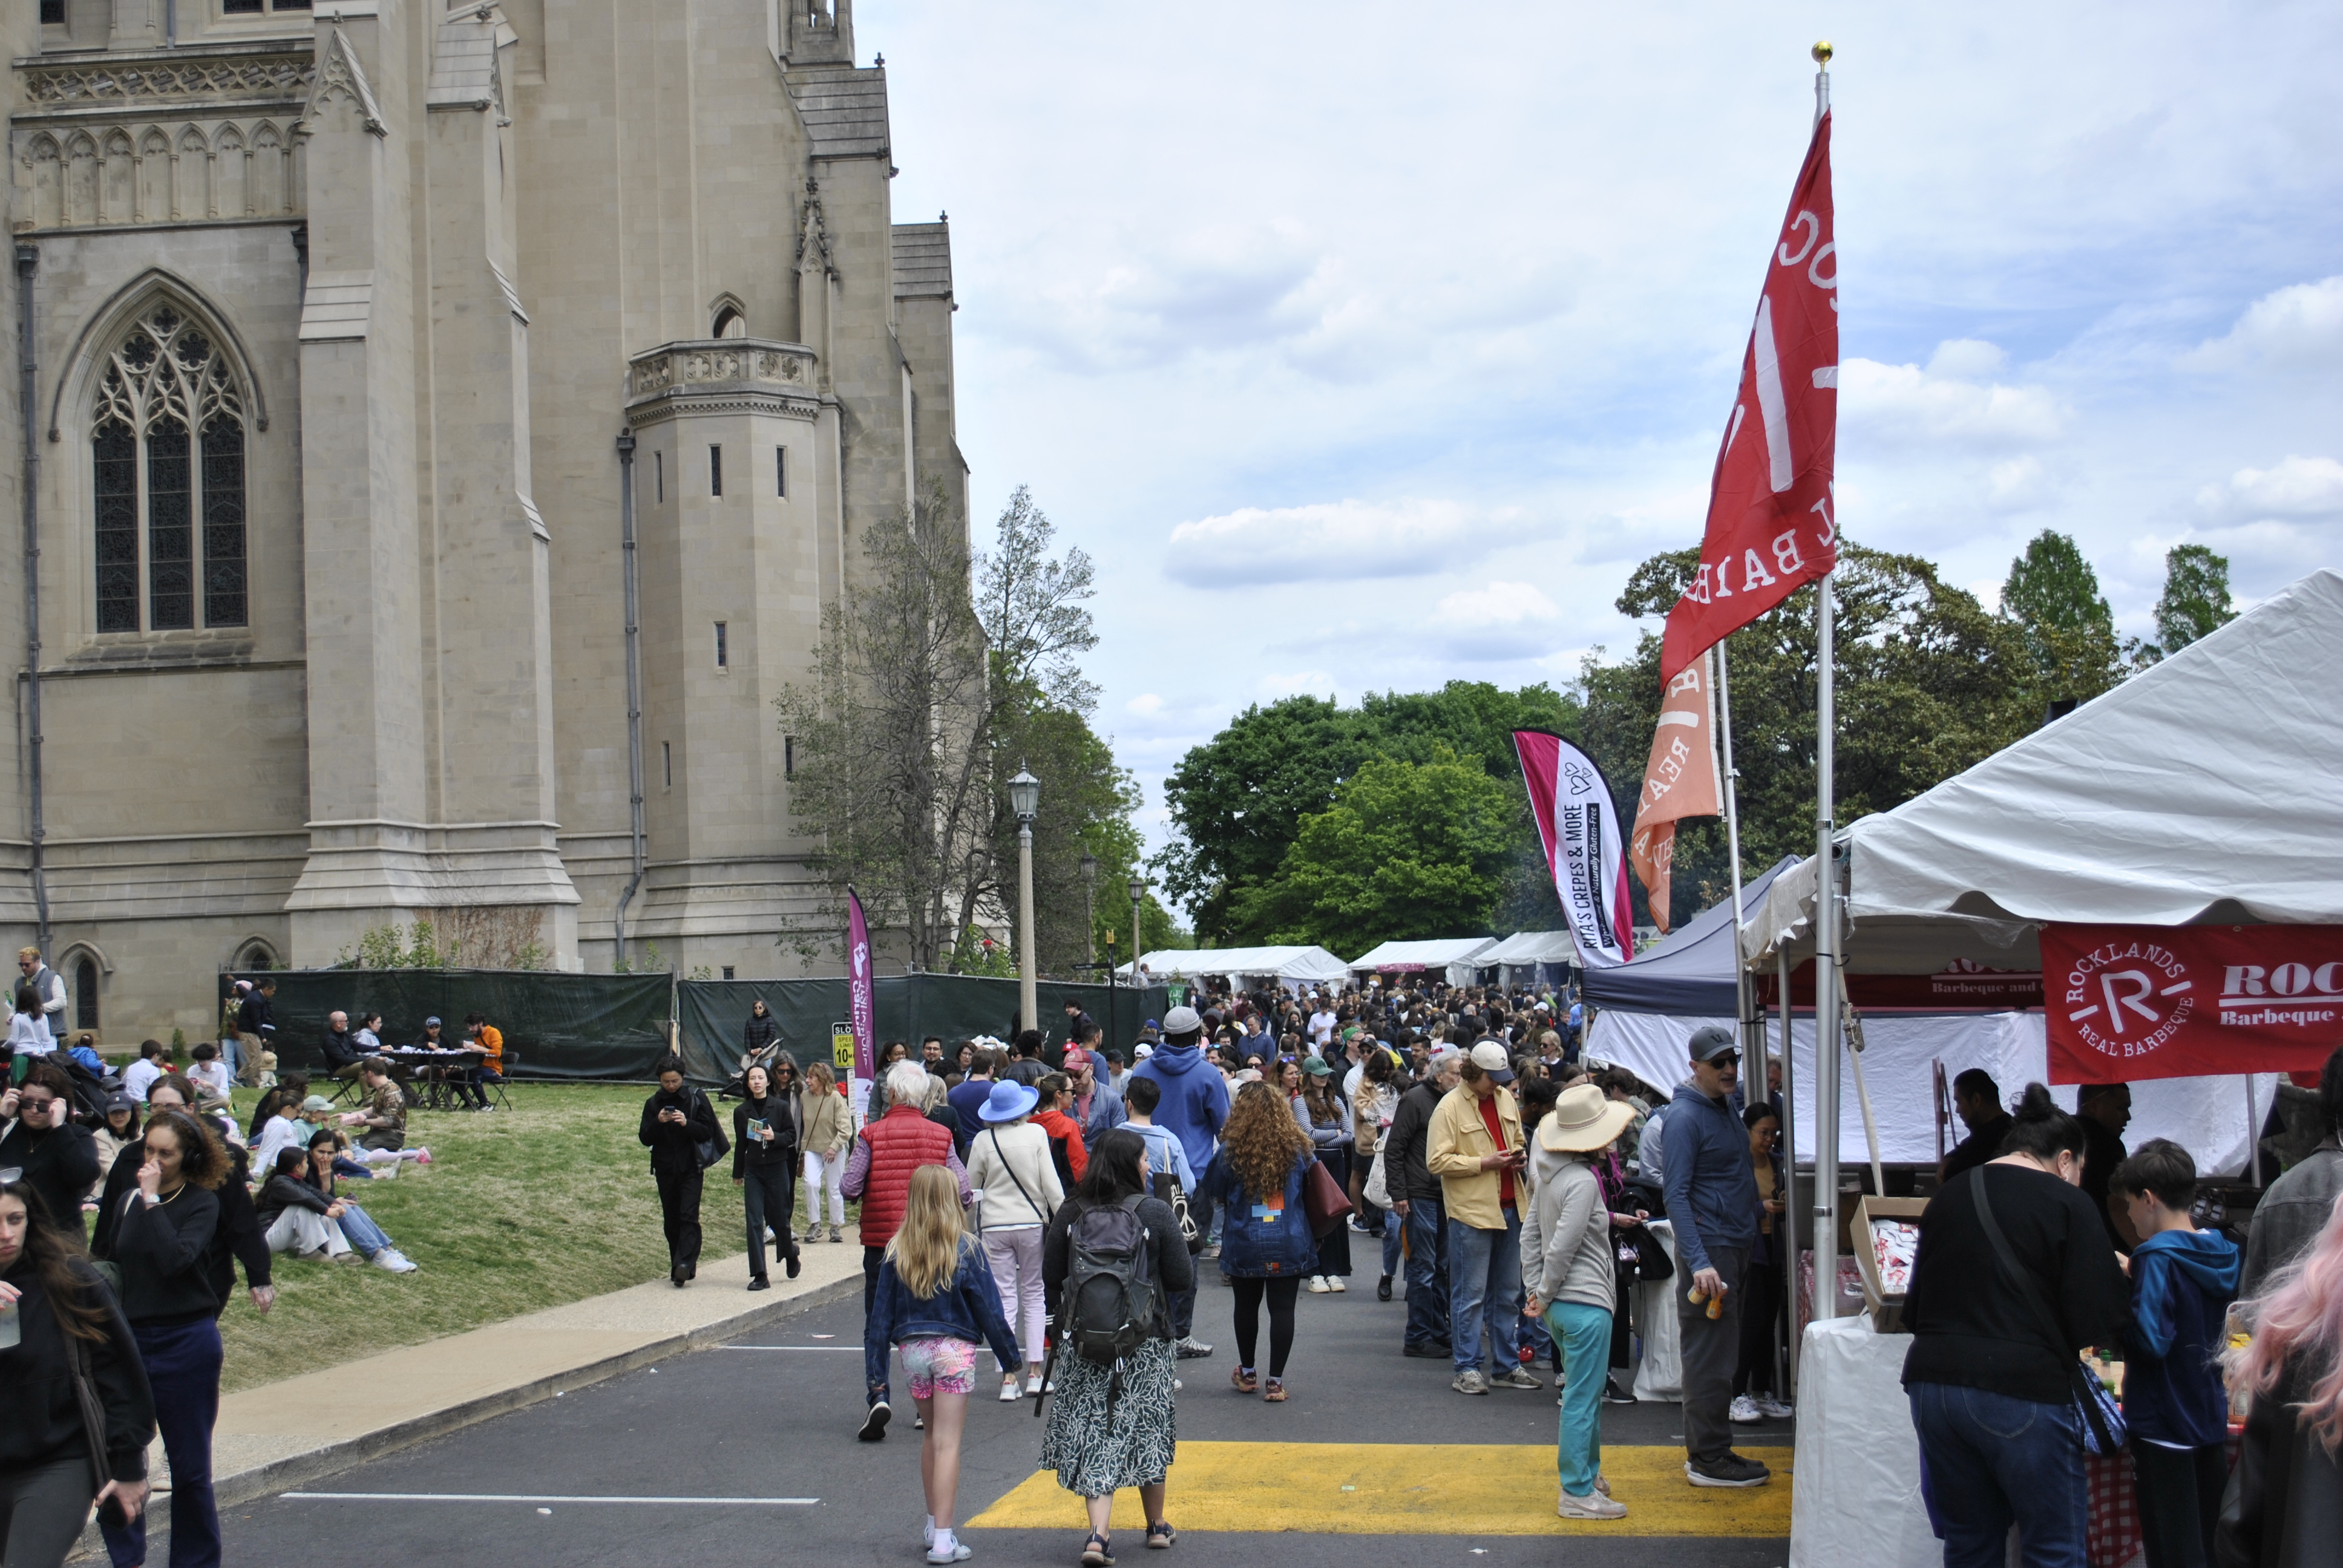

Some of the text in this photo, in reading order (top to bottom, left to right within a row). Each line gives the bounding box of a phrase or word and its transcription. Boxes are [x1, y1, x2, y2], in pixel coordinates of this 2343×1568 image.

[1588, 806, 1598, 855] Gluten-Free
[1564, 804, 1598, 949] RITA'S CREPES & MORE
[1590, 855, 1601, 894] Naturally
[1932, 982, 2004, 995] Barbeque
[2009, 982, 2036, 991] and
[2066, 942, 2185, 1004] ROCKLANDS
[2078, 998, 2193, 1057] REAL BARBEQUE
[2219, 1008, 2335, 1027] Barbeque
[836, 1048, 848, 1063] 10
